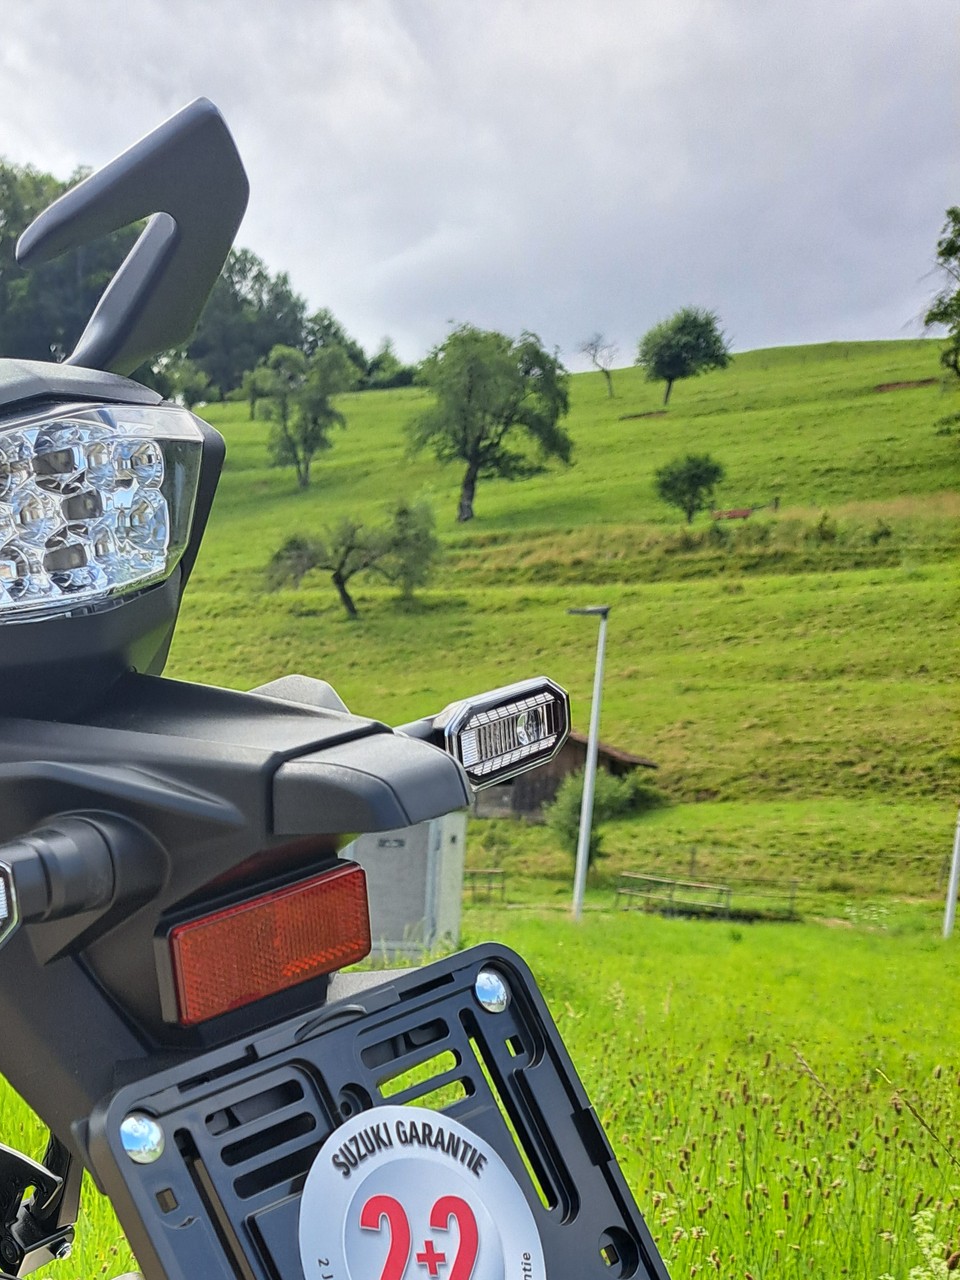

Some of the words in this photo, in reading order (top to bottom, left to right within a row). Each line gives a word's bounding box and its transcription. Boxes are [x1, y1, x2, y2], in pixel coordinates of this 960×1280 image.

[332, 1122, 394, 1179] SUZUKI
[396, 1120, 488, 1179] GARANTIE
[318, 1257, 330, 1267] 2
